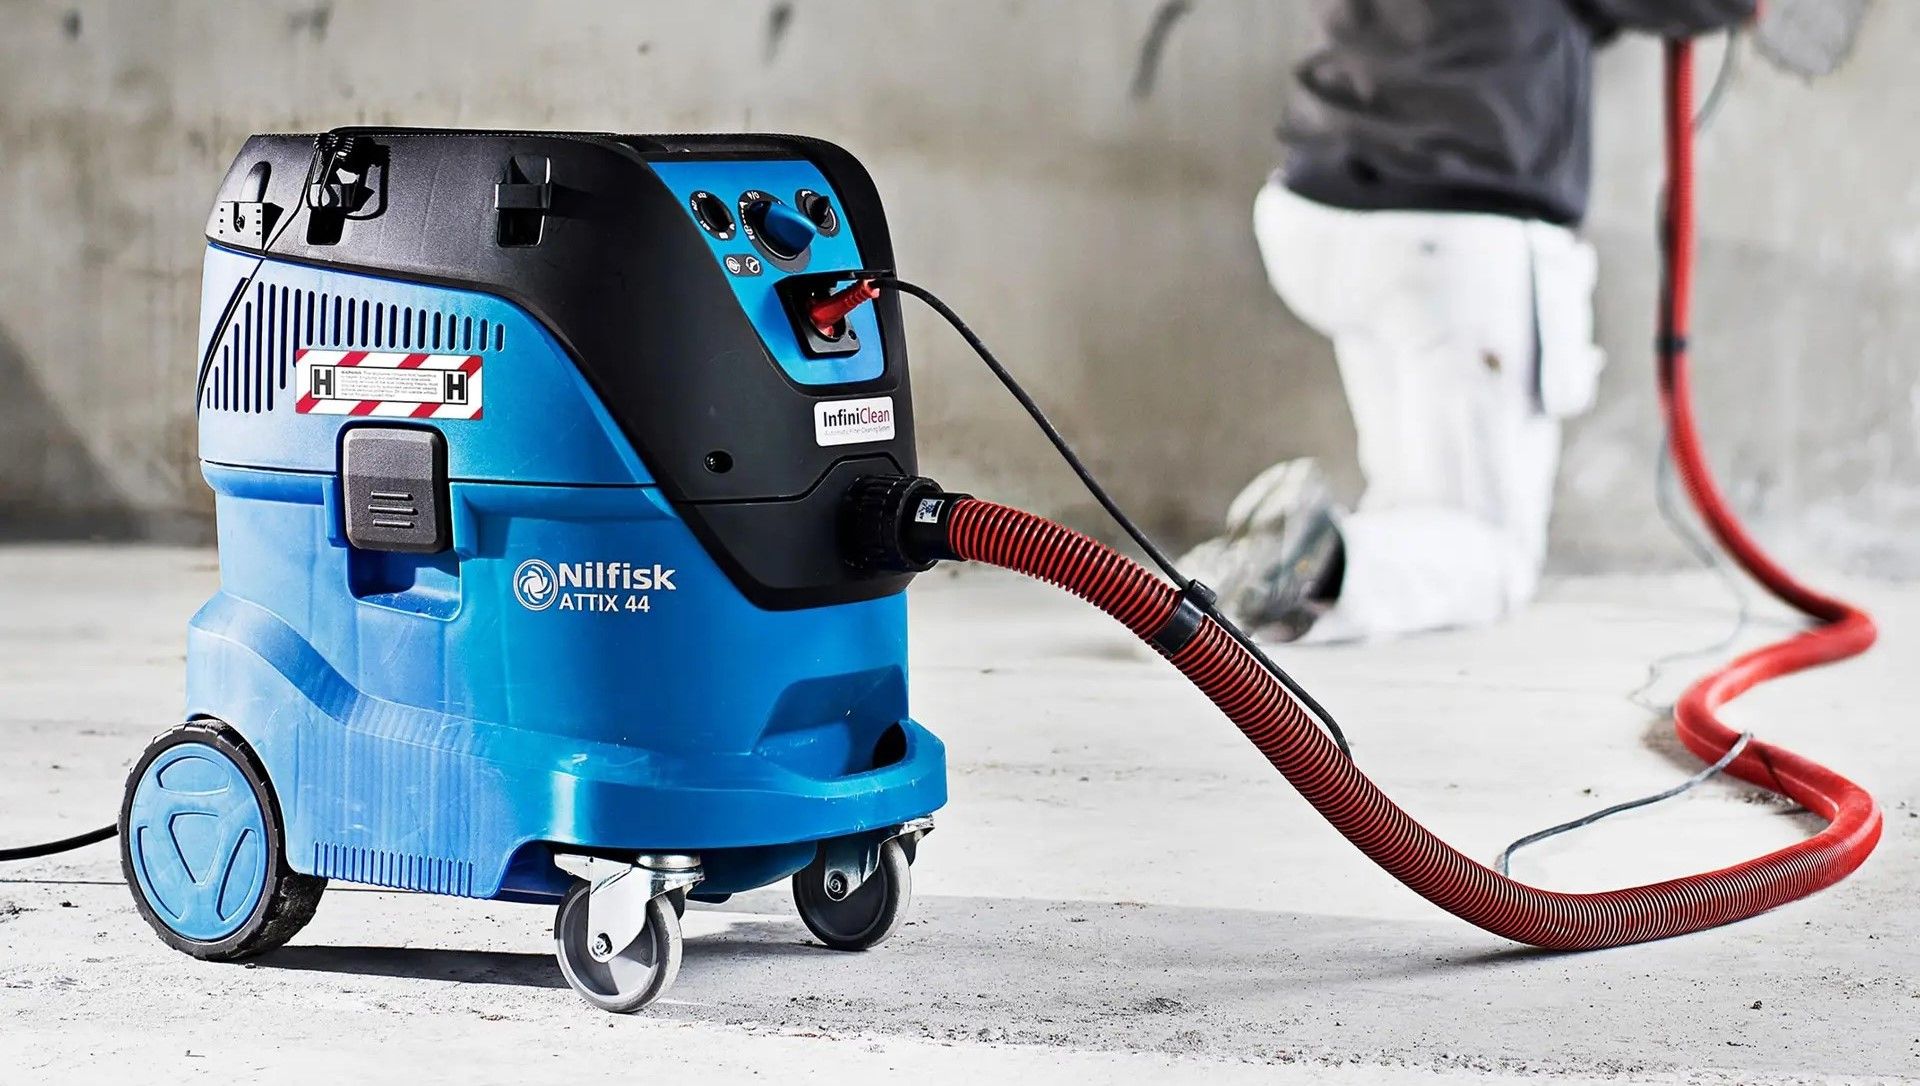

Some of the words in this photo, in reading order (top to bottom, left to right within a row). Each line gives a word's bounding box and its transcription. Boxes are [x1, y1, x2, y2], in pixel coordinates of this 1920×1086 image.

[313, 369, 332, 396] H
[446, 373, 465, 400] H
[823, 406, 890, 428] InfiniClean
[558, 562, 677, 591] Nilfisk
[558, 592, 619, 612] ATTIX
[624, 595, 651, 613] 44
